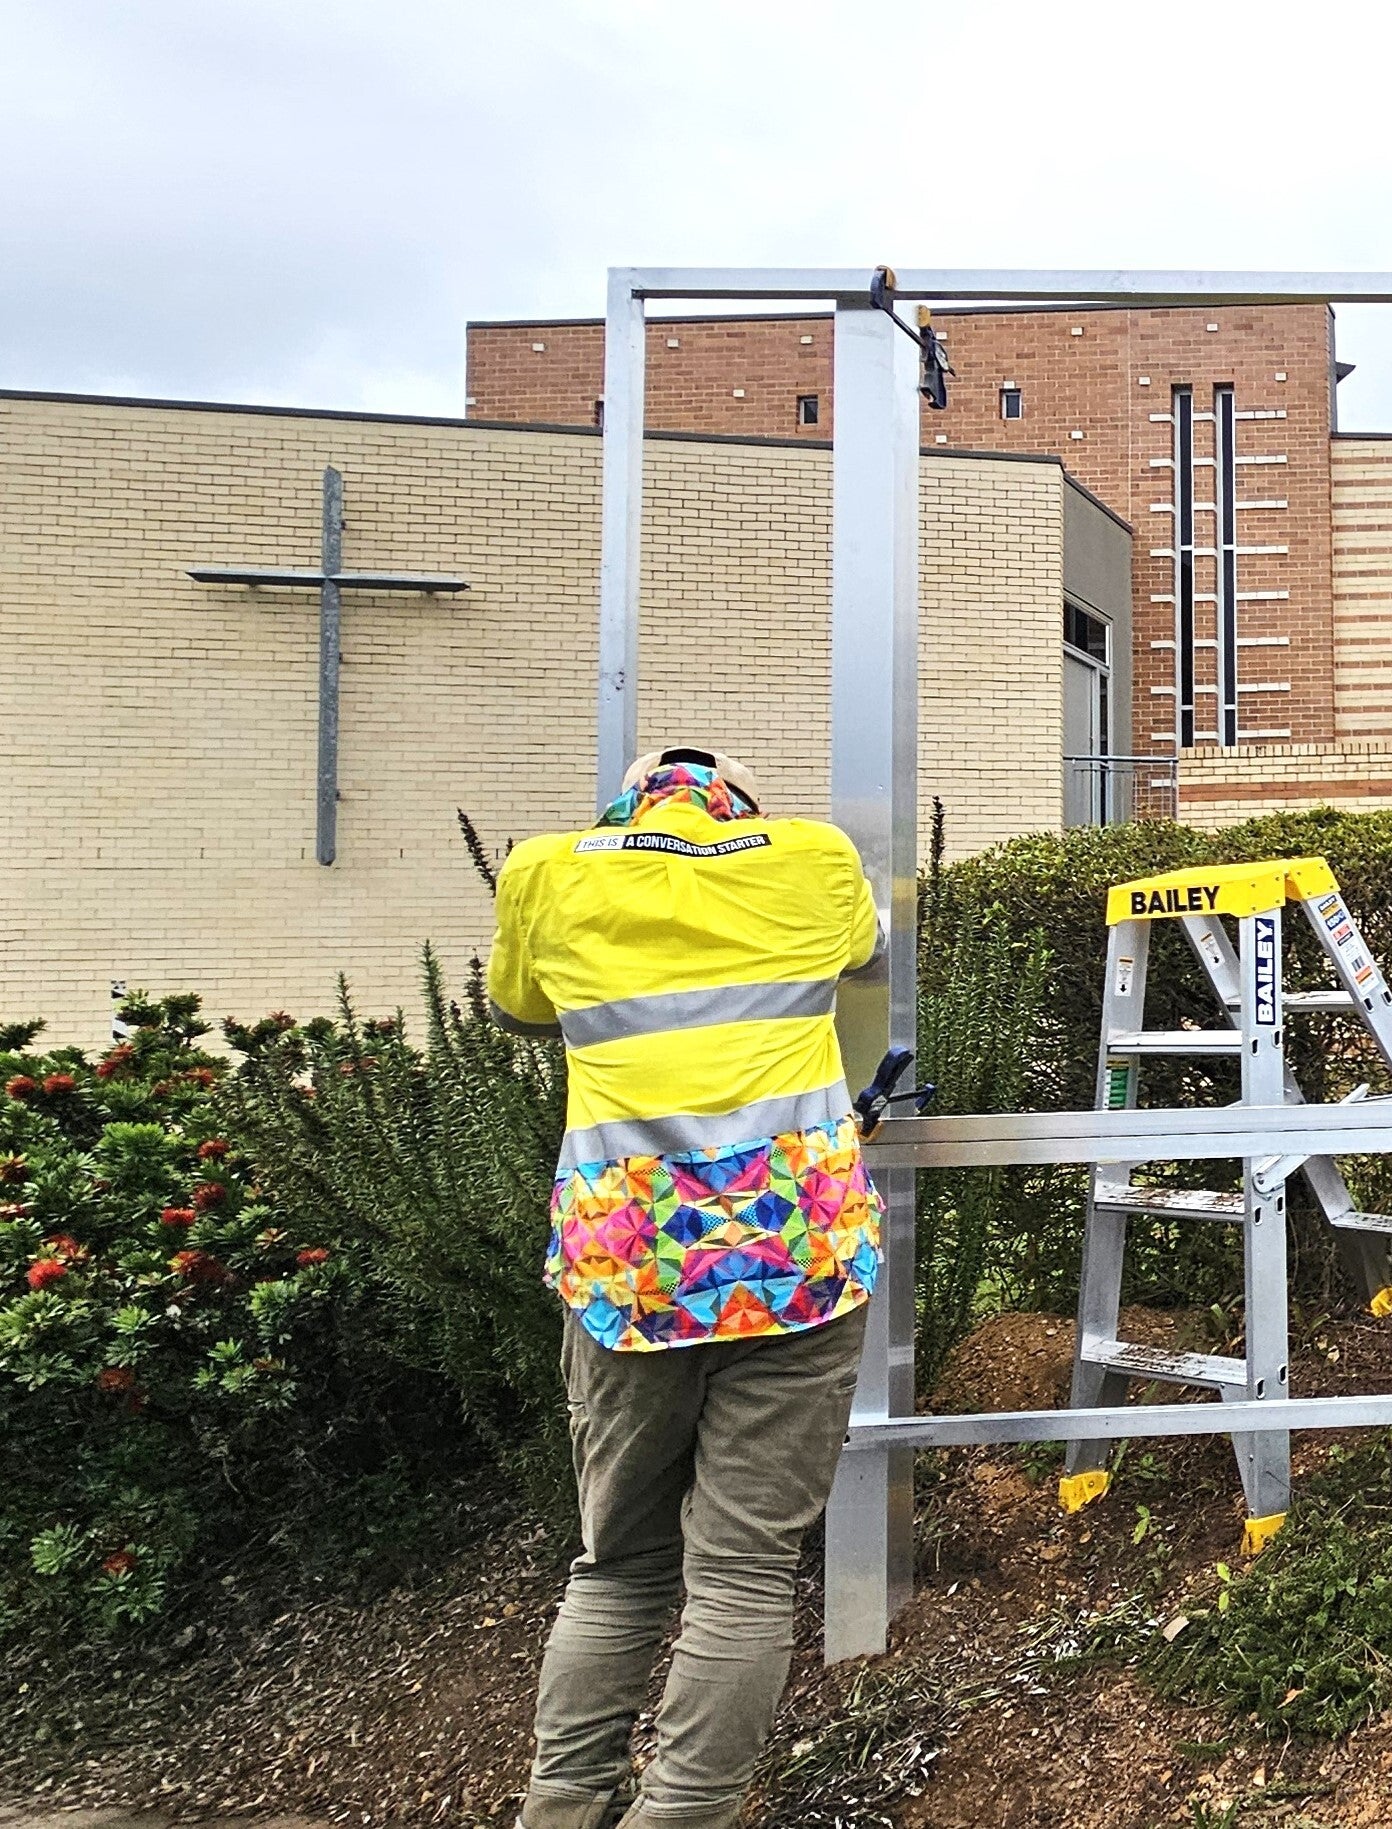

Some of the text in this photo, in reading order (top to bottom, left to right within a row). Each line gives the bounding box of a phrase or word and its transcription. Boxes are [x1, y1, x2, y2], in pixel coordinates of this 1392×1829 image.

[582, 835, 766, 856] THIS IS A CONVERSATION STARTER
[1130, 885, 1220, 915] BAILEY
[1256, 920, 1274, 1023] BAILEY
